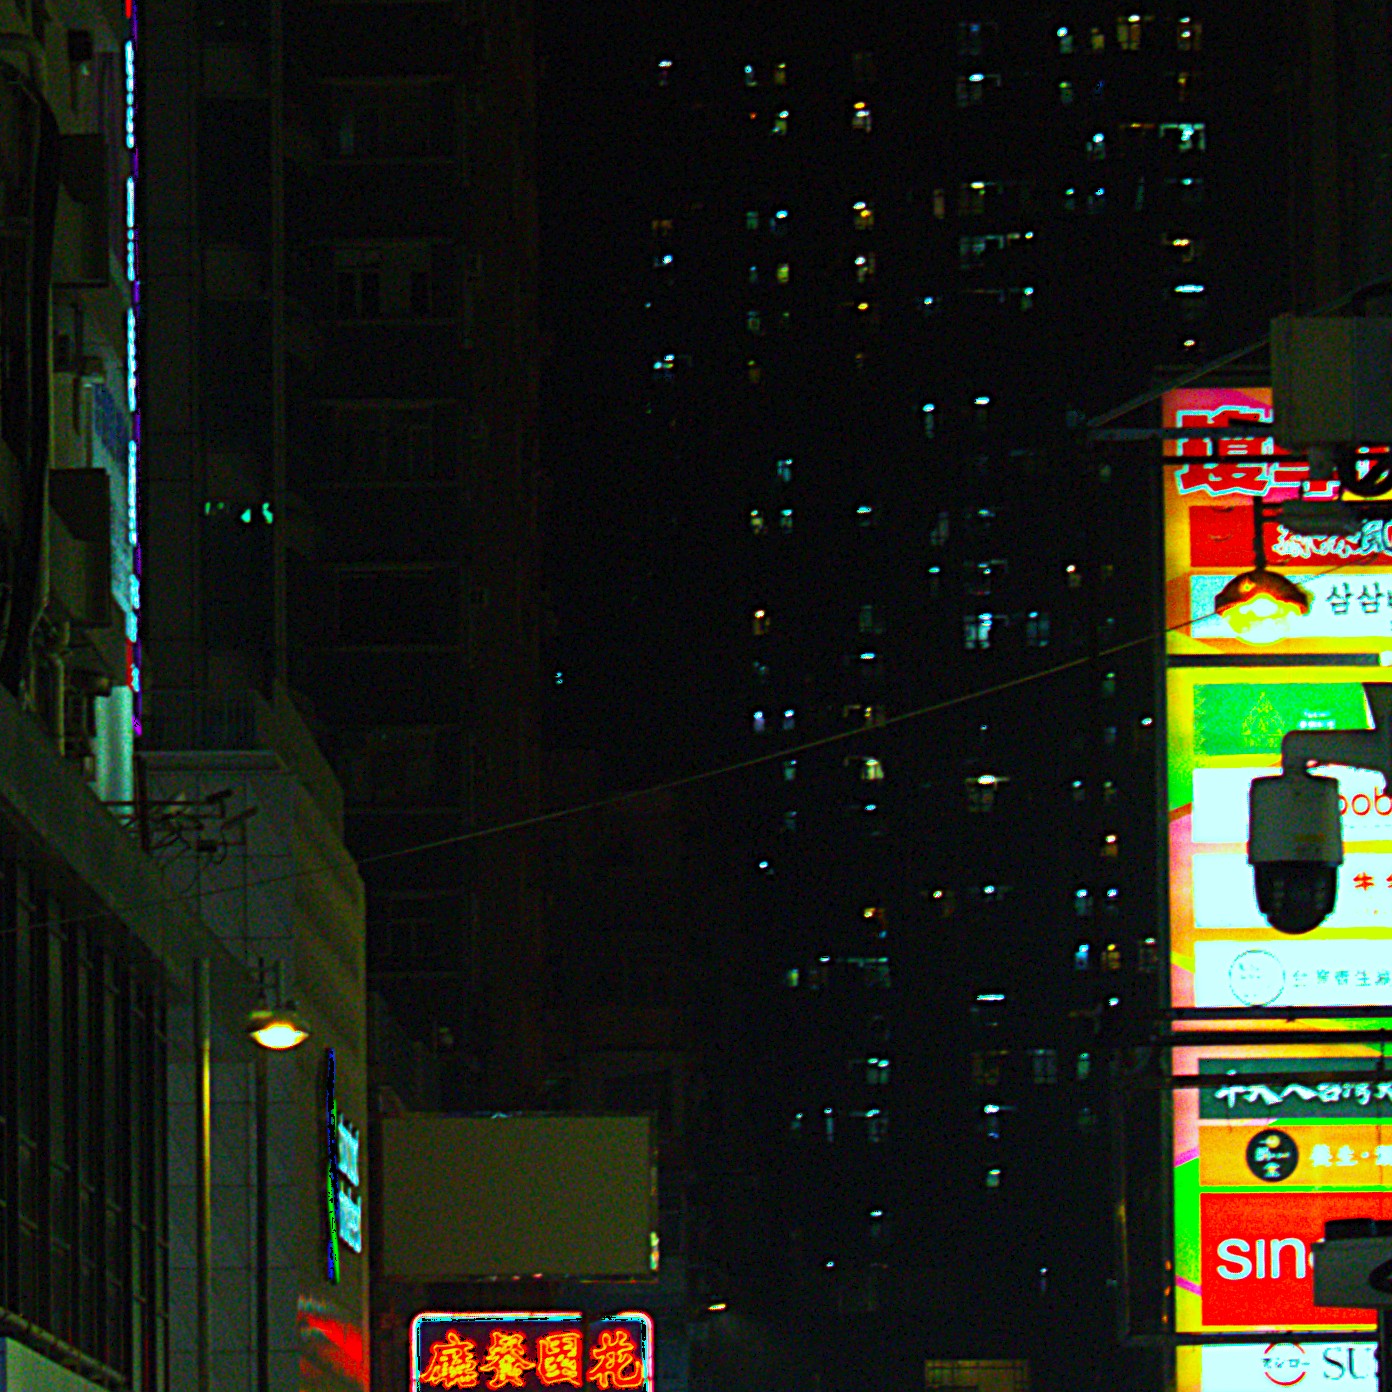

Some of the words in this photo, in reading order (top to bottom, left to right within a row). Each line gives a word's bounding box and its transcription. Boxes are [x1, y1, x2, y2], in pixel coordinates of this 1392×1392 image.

[1325, 581, 1392, 616] 삼삼
[1217, 1237, 1315, 1280] sin
[1322, 1346, 1378, 1381] SU
